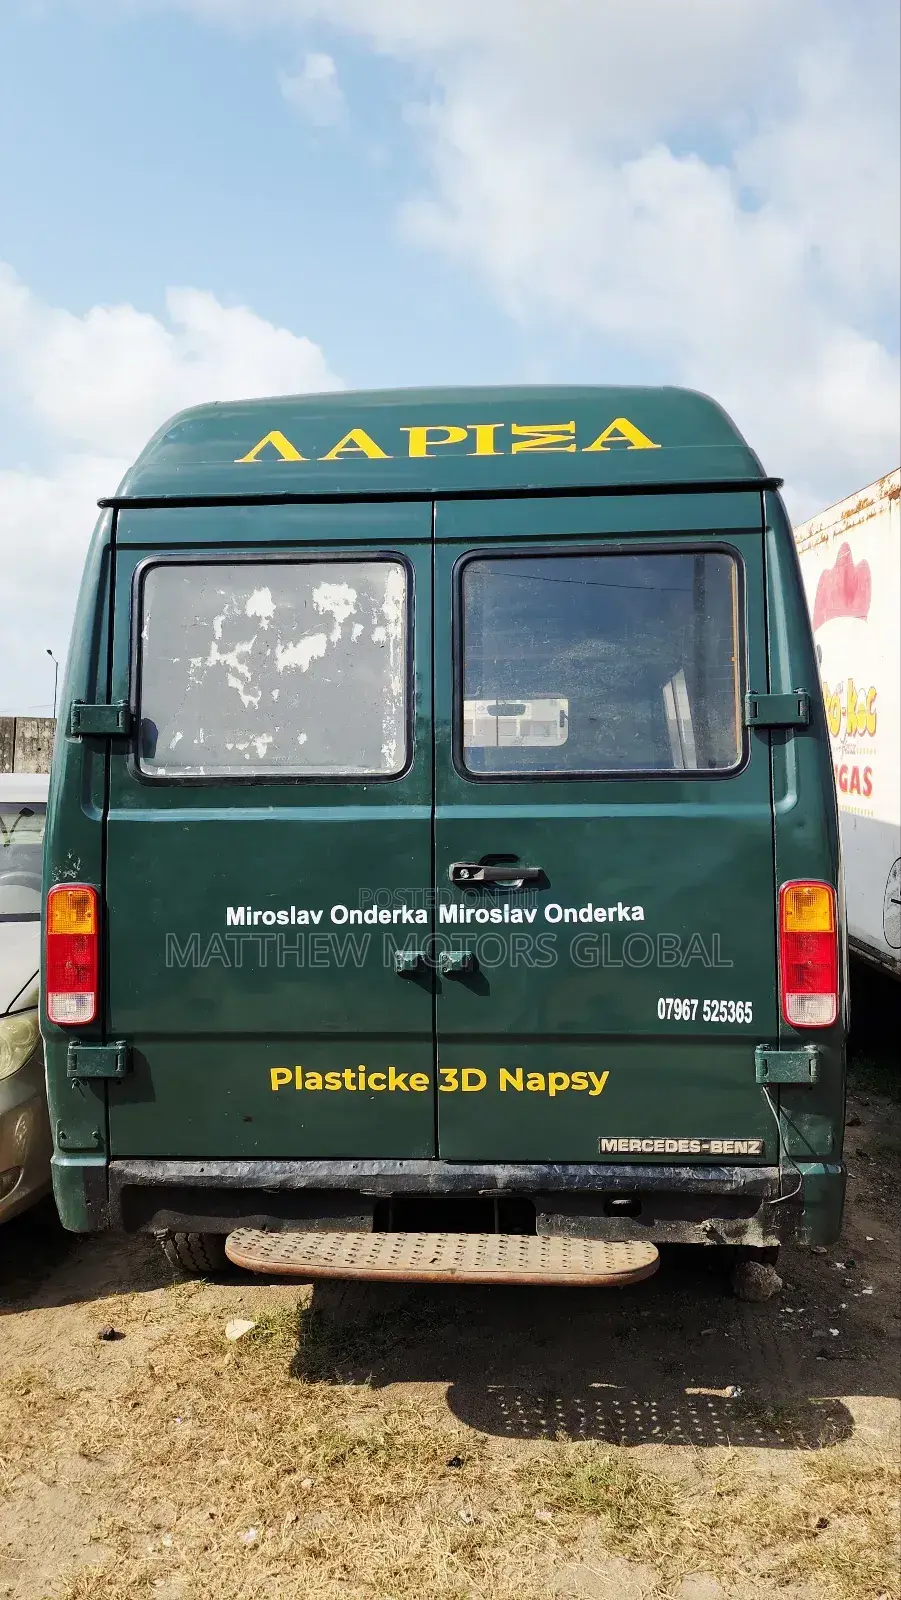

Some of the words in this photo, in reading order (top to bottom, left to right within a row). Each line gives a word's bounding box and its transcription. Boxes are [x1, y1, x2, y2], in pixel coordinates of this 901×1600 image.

[226, 905, 323, 926] Miroslav
[330, 904, 428, 925] Onderka
[439, 903, 537, 924] Miroslav
[544, 902, 645, 923] Onderka
[657, 997, 698, 1020] 07967
[702, 999, 753, 1024] 525365
[270, 1065, 430, 1092] Plasticke
[438, 1067, 487, 1092] 3D
[499, 1068, 610, 1097] Napsy
[601, 1138, 761, 1154] MERCEDES-BENZ
